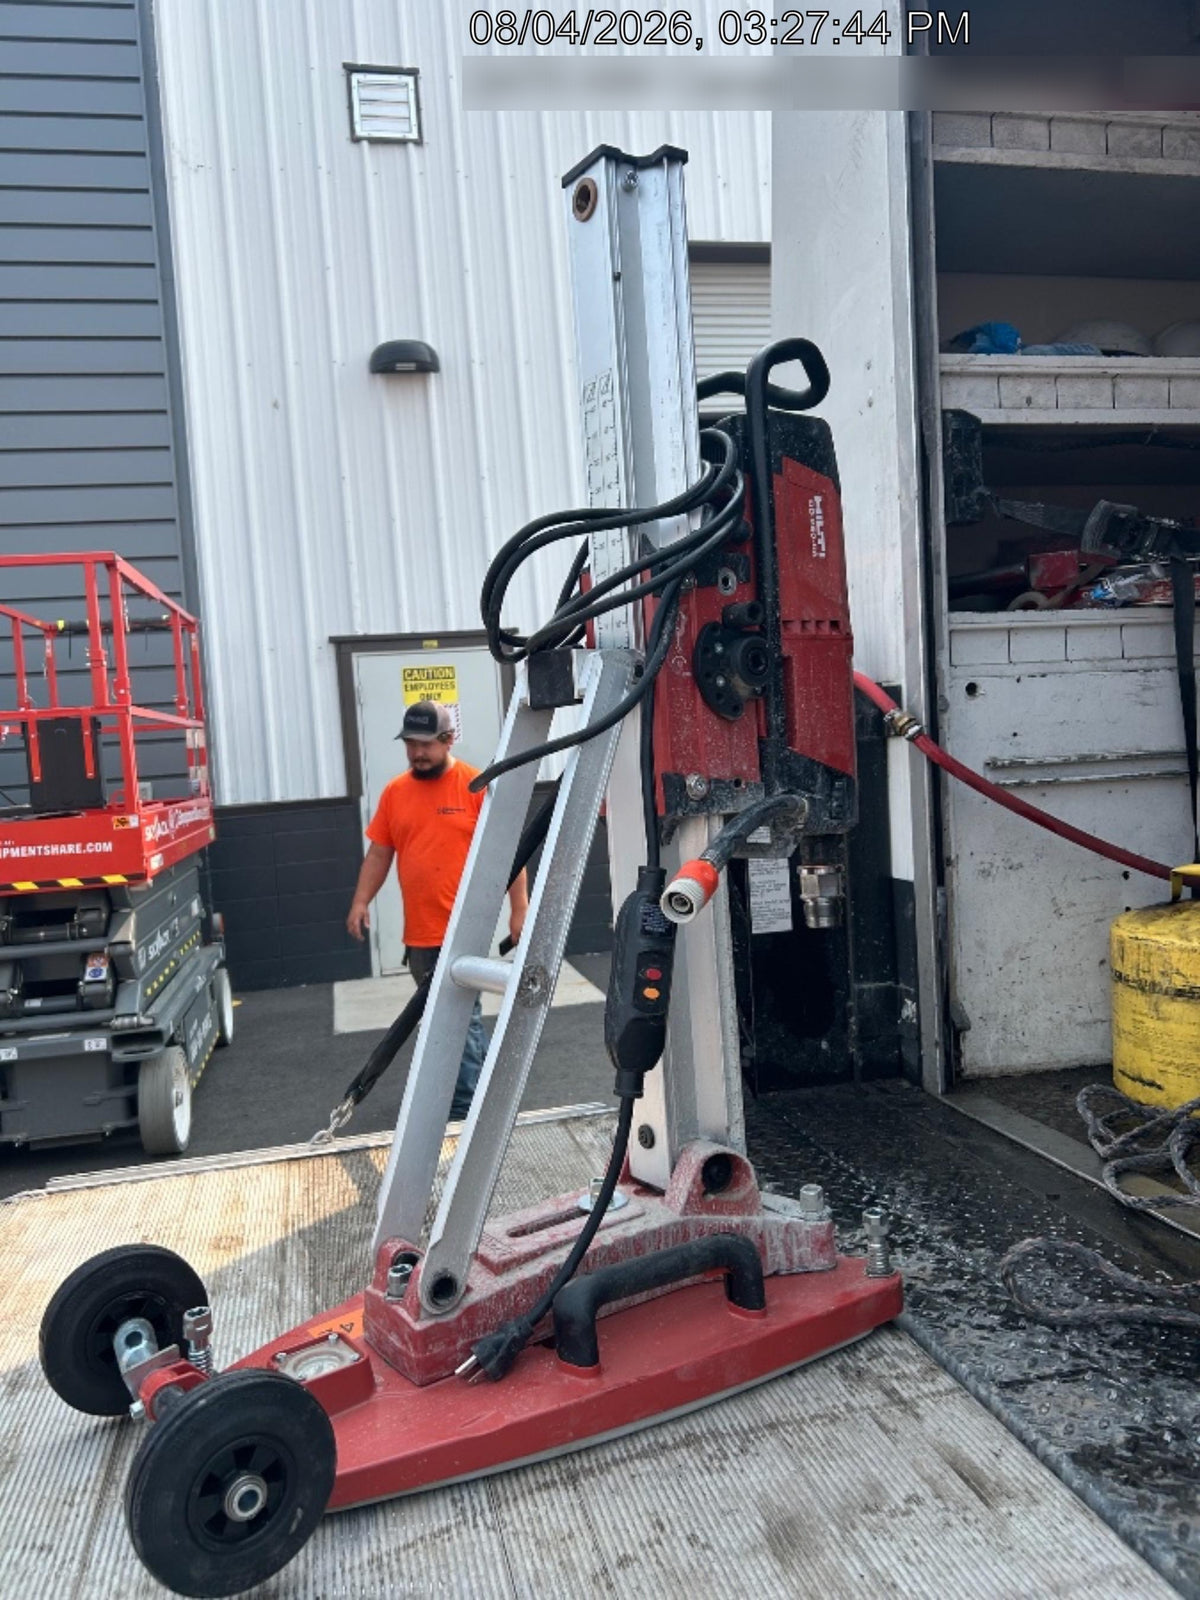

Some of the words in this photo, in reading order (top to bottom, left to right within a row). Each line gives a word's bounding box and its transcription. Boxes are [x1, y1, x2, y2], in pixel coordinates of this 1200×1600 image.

[813, 495, 826, 557] HILTI
[404, 667, 454, 680] CAUTION
[404, 681, 456, 692] EMPLOYEES
